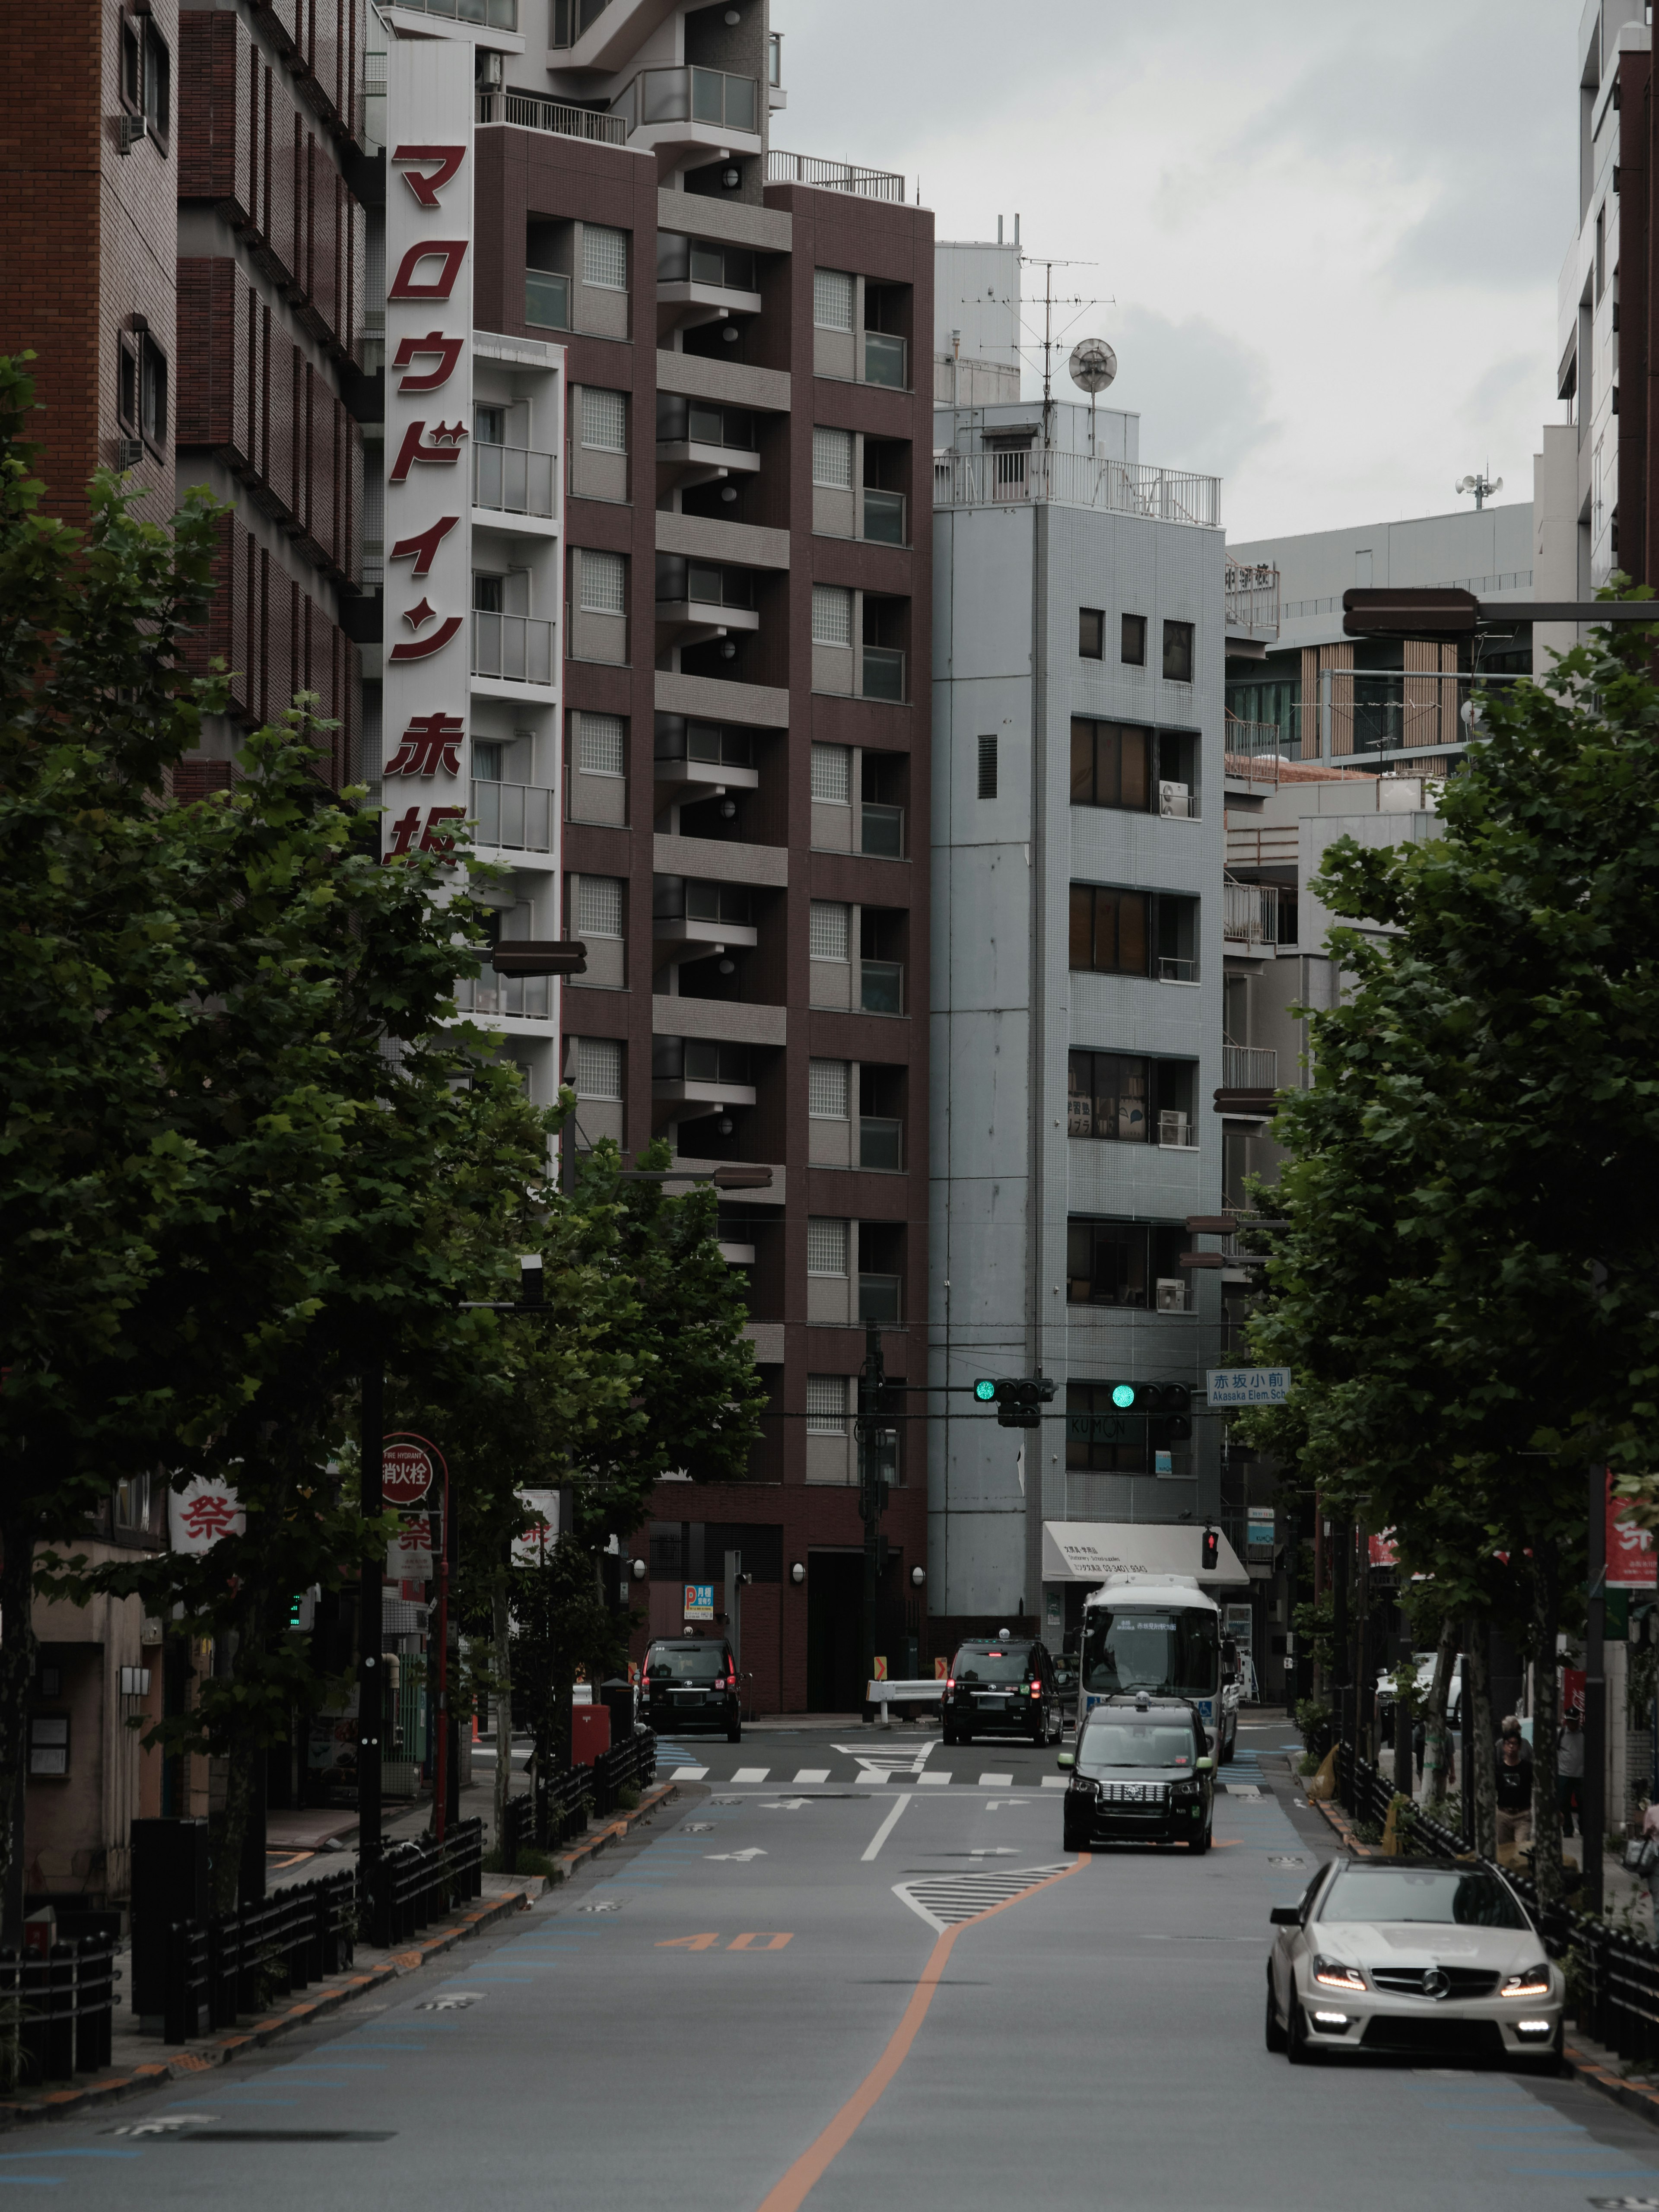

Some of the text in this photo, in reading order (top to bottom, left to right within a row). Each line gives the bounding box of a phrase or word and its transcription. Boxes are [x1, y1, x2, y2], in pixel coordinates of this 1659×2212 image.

[1214, 1373, 1283, 1389] 赤坂小前
[1213, 1391, 1246, 1401] Akasaka
[1249, 1390, 1269, 1400] Elem.
[1072, 1417, 1125, 1438] KUMON
[383, 1462, 427, 1484] 消火栓
[179, 1495, 240, 1540] 祭
[1256, 1534, 1273, 1543] KUMON
[1103, 1564, 1147, 1573] 03-3401-9343
[686, 1586, 696, 1610] P
[698, 1587, 712, 1597] 月極
[654, 1932, 795, 1951] 40
